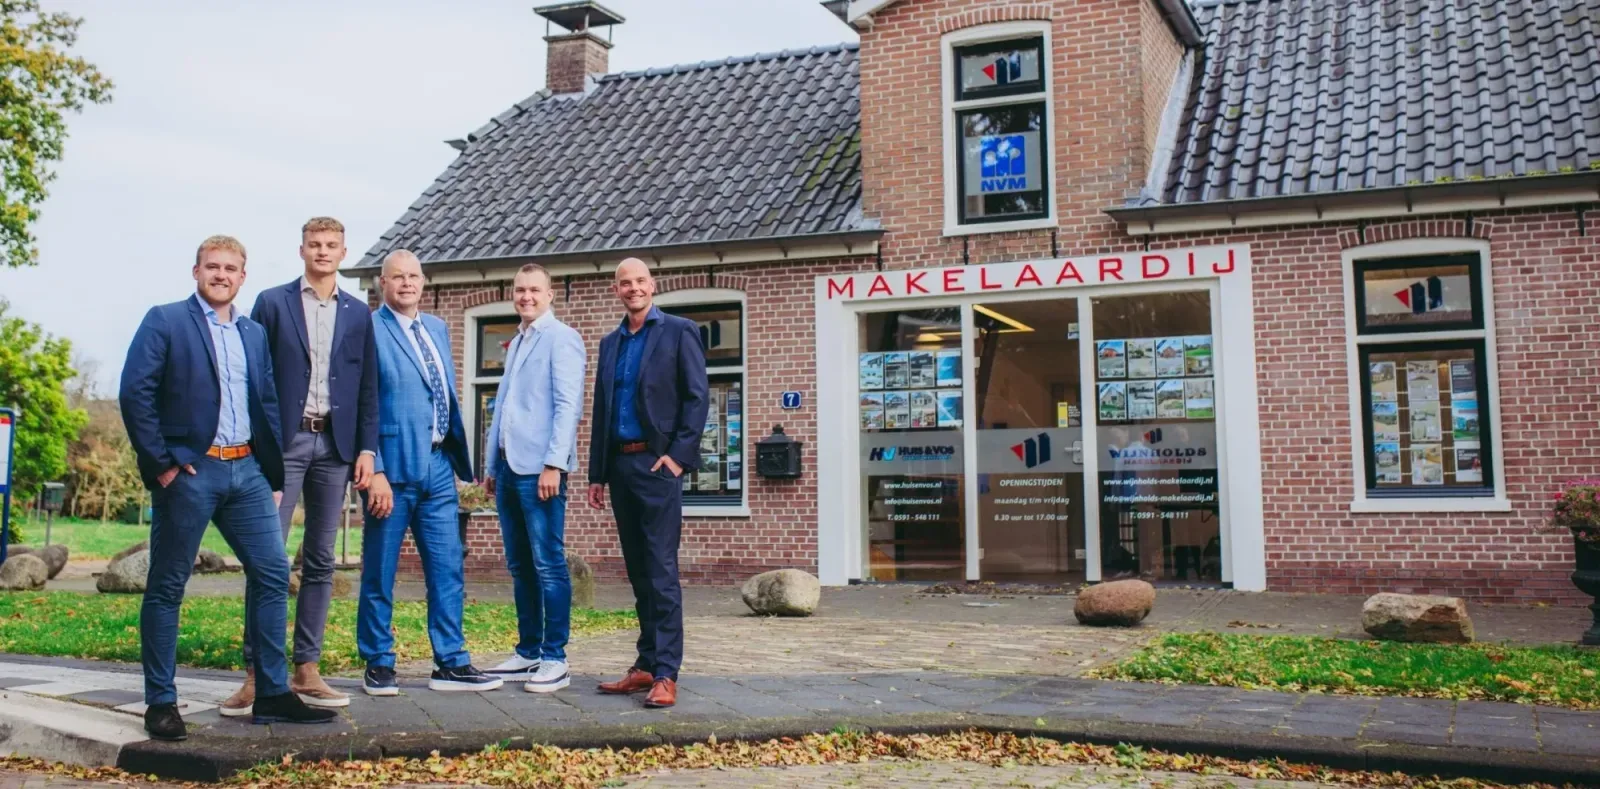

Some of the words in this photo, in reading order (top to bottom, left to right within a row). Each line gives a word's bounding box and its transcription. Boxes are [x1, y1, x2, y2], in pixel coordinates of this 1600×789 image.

[981, 177, 1026, 192] NVM
[827, 249, 1235, 300] MAKELAARDIJ
[787, 393, 795, 407] 7
[1108, 447, 1207, 459] WIJNHOLDS
[884, 481, 942, 489] www.huisenvos.nl
[999, 479, 1063, 487] OPENINGSTIJDEN
[1103, 476, 1213, 487] www.wijnholds-makelaardij.nl
[884, 497, 943, 506] info@huisenvos.nl
[994, 497, 1027, 506] maandag
[1043, 497, 1070, 505] vrijdag
[1104, 494, 1214, 503] info@wijnholds-makelaardij.nl
[1160, 511, 1174, 519] 548
